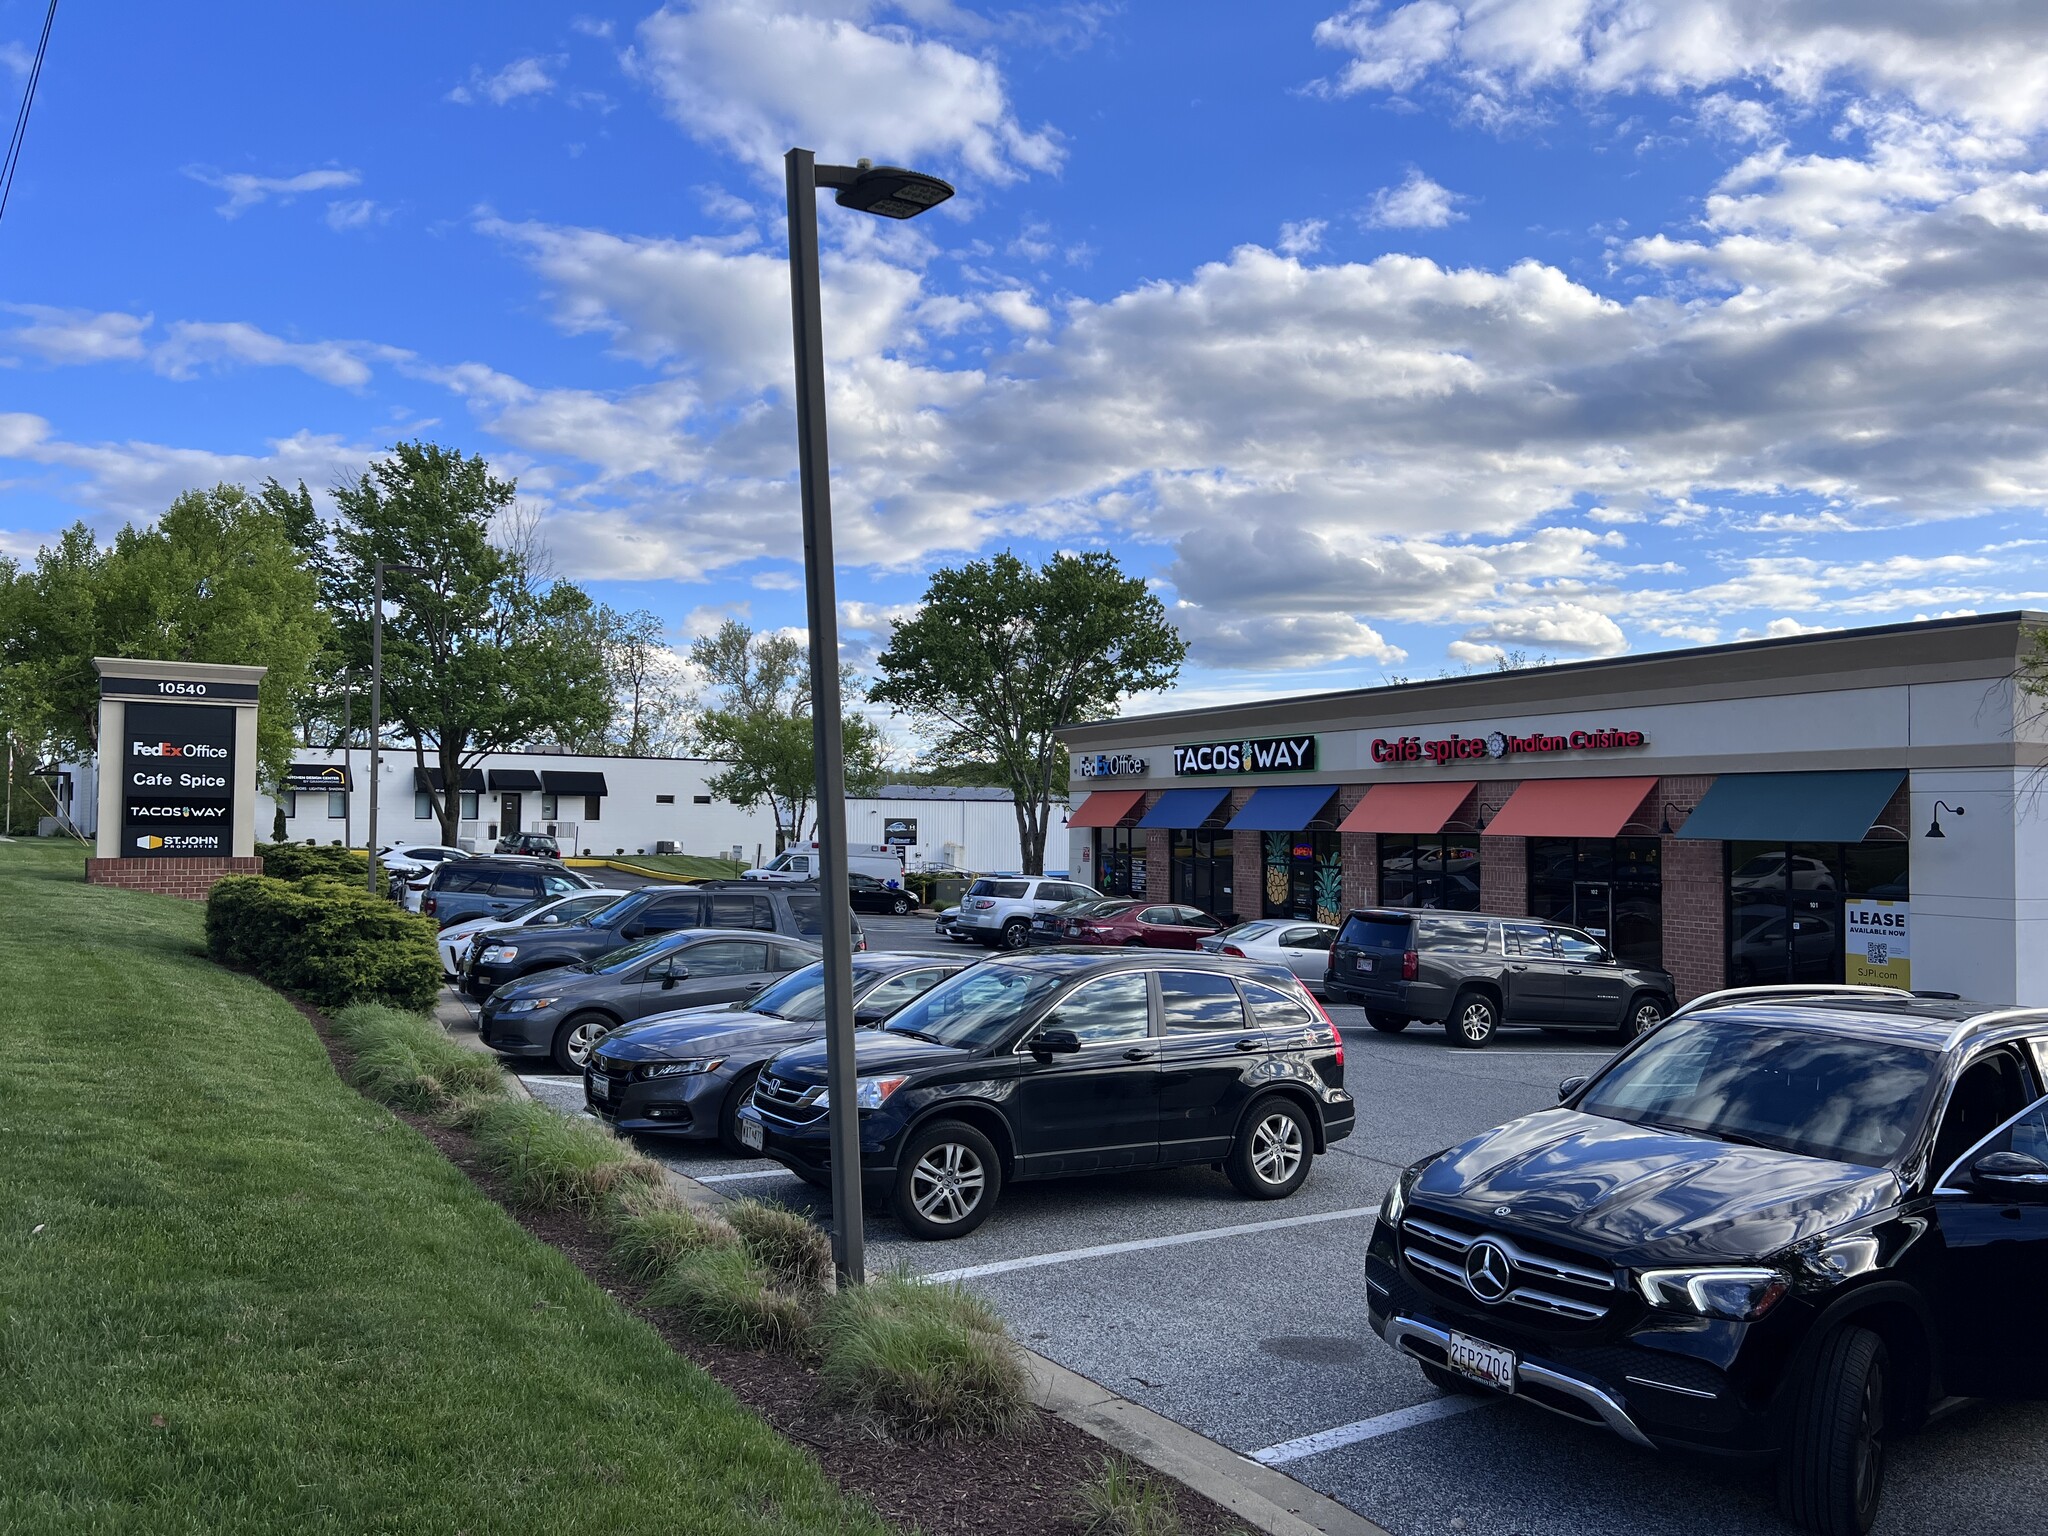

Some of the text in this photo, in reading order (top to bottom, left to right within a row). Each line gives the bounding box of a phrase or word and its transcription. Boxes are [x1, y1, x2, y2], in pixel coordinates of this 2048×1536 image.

[158, 683, 206, 695] 10540
[1371, 728, 1640, 765] Café spice Indian Cuisine
[1174, 739, 1309, 771] TACOS WAY
[133, 772, 226, 788] Cafe Spice
[131, 807, 226, 817] TACOS WAY
[1293, 847, 1312, 856] OPEN
[1850, 910, 1905, 927] LEASE
[1849, 927, 1887, 936] AVAILABLE
[1857, 968, 1898, 980] SJPI.com
[1452, 1343, 1509, 1381] 2EP2706
